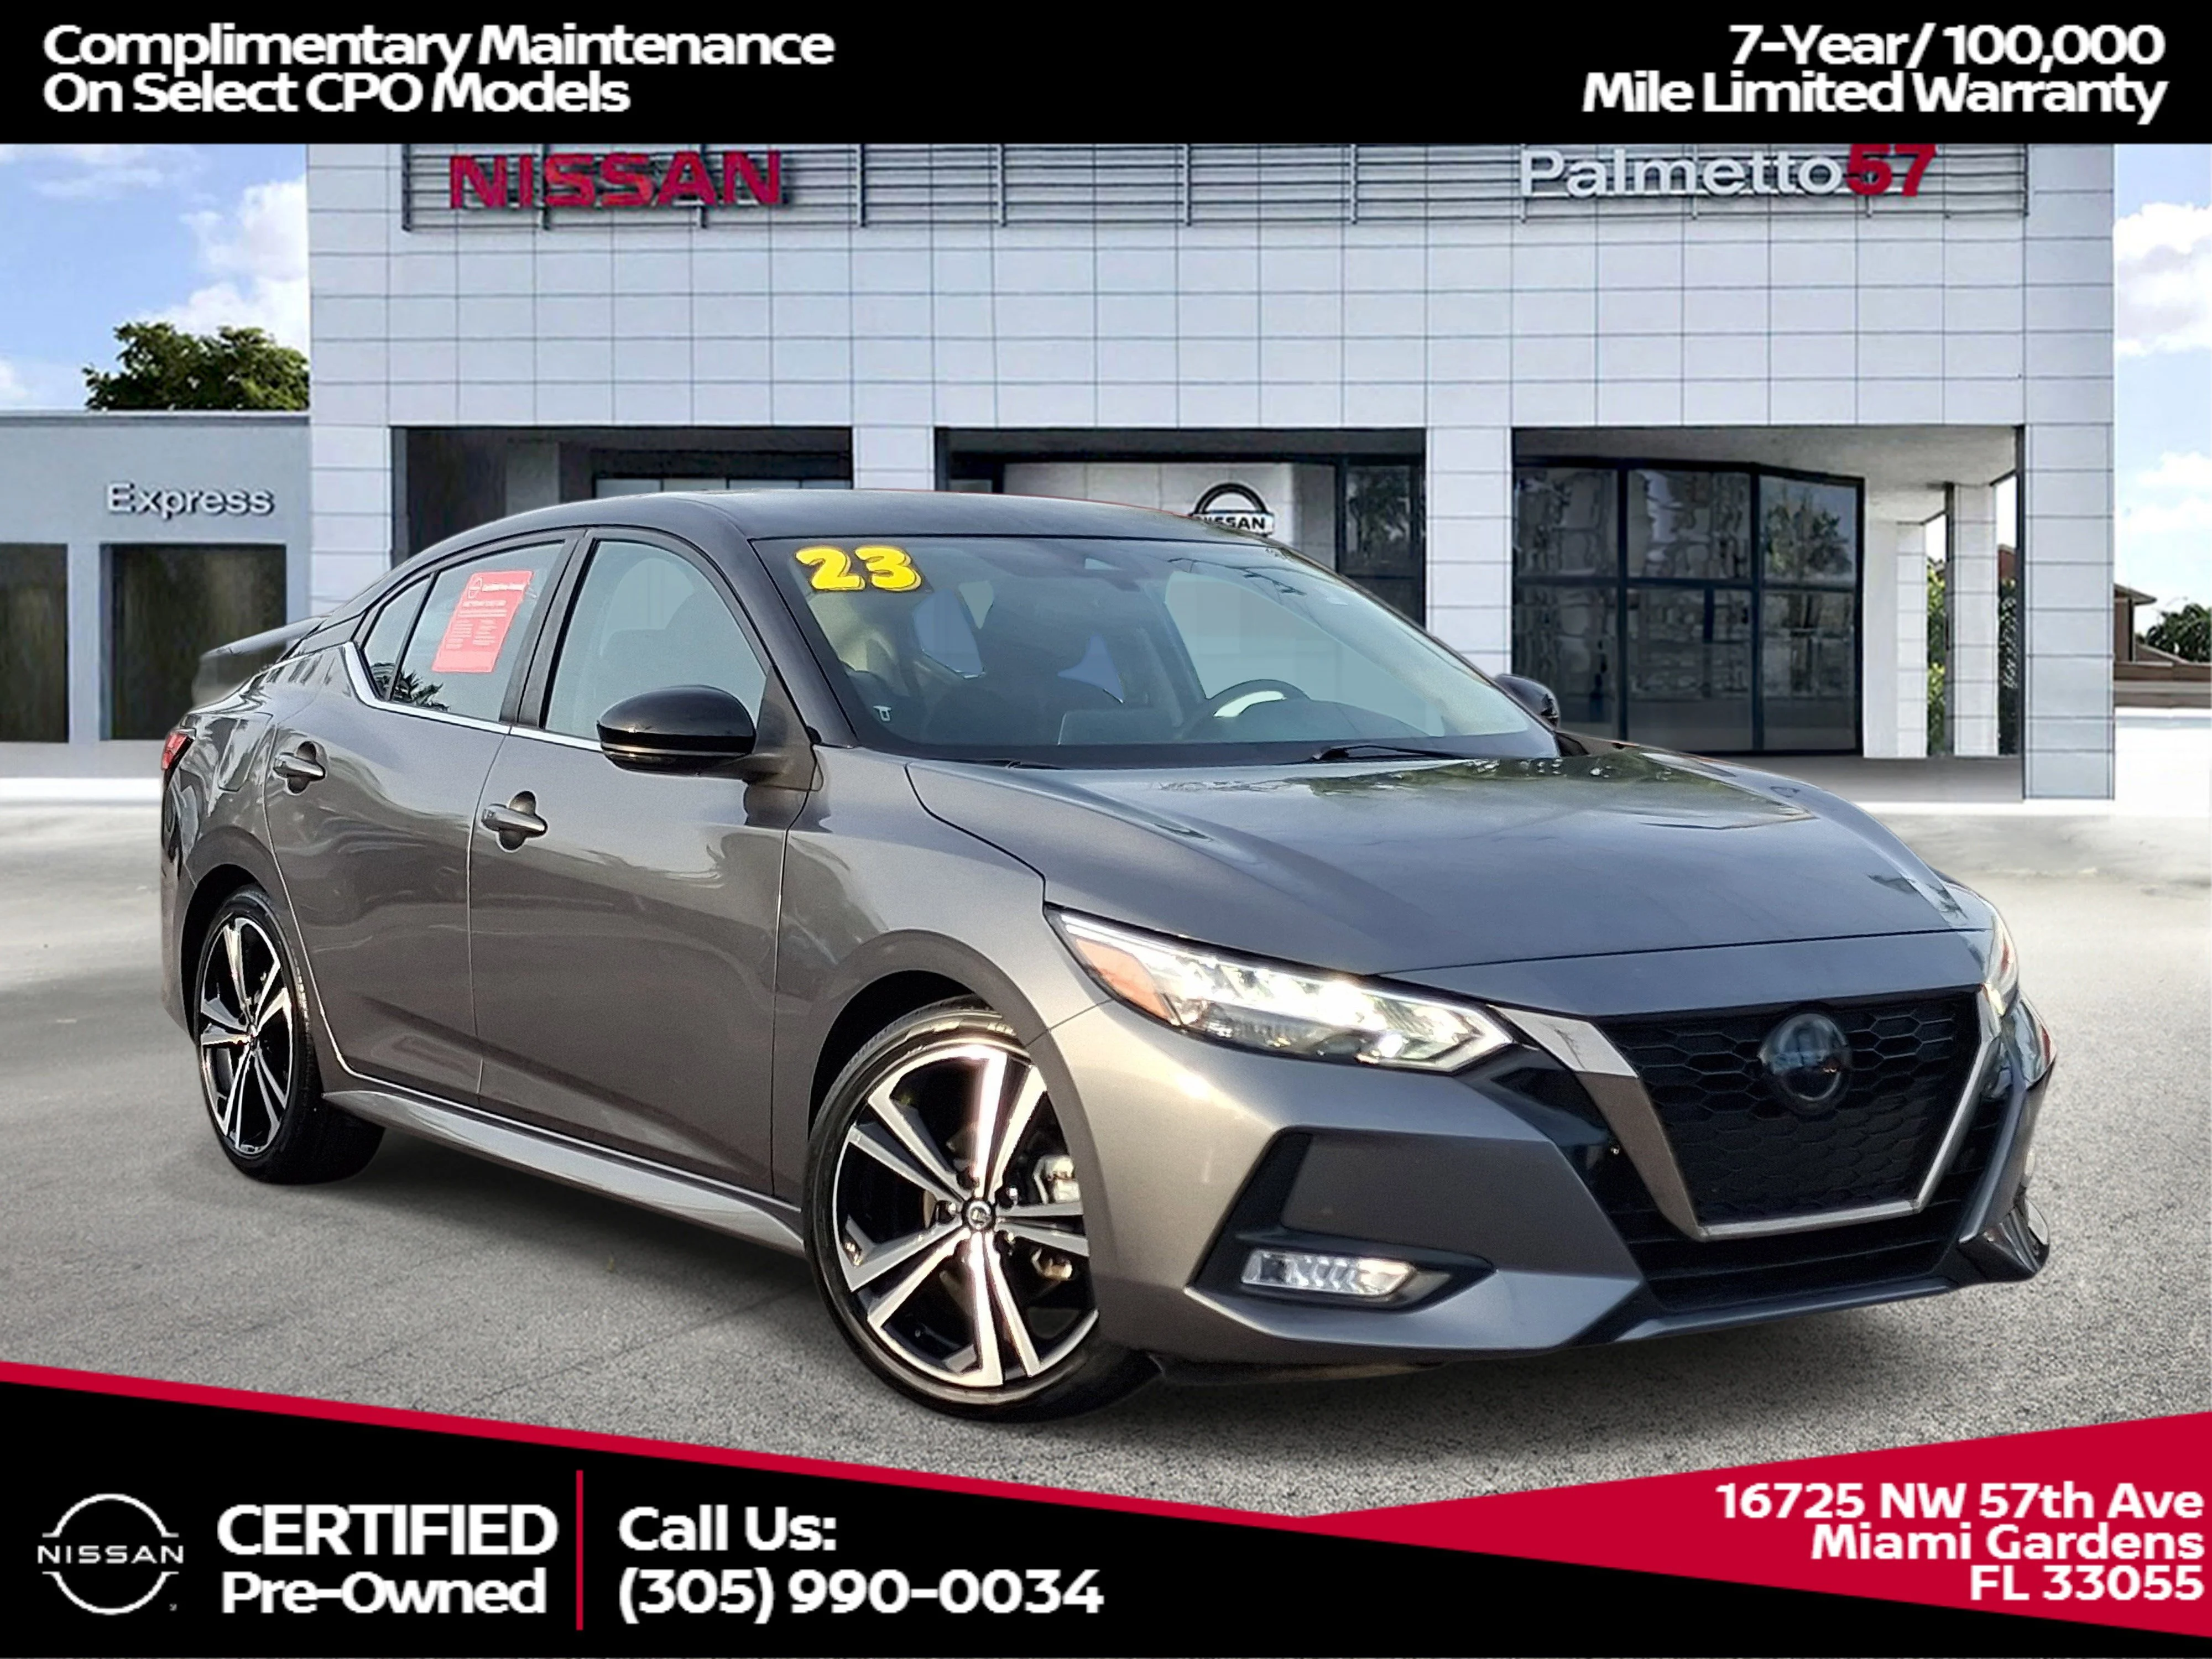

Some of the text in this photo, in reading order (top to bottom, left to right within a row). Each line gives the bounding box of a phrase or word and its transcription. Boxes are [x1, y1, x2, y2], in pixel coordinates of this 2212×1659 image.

[450, 149, 781, 208] NISSAN
[107, 483, 275, 519] Express
[795, 545, 922, 592] 23
